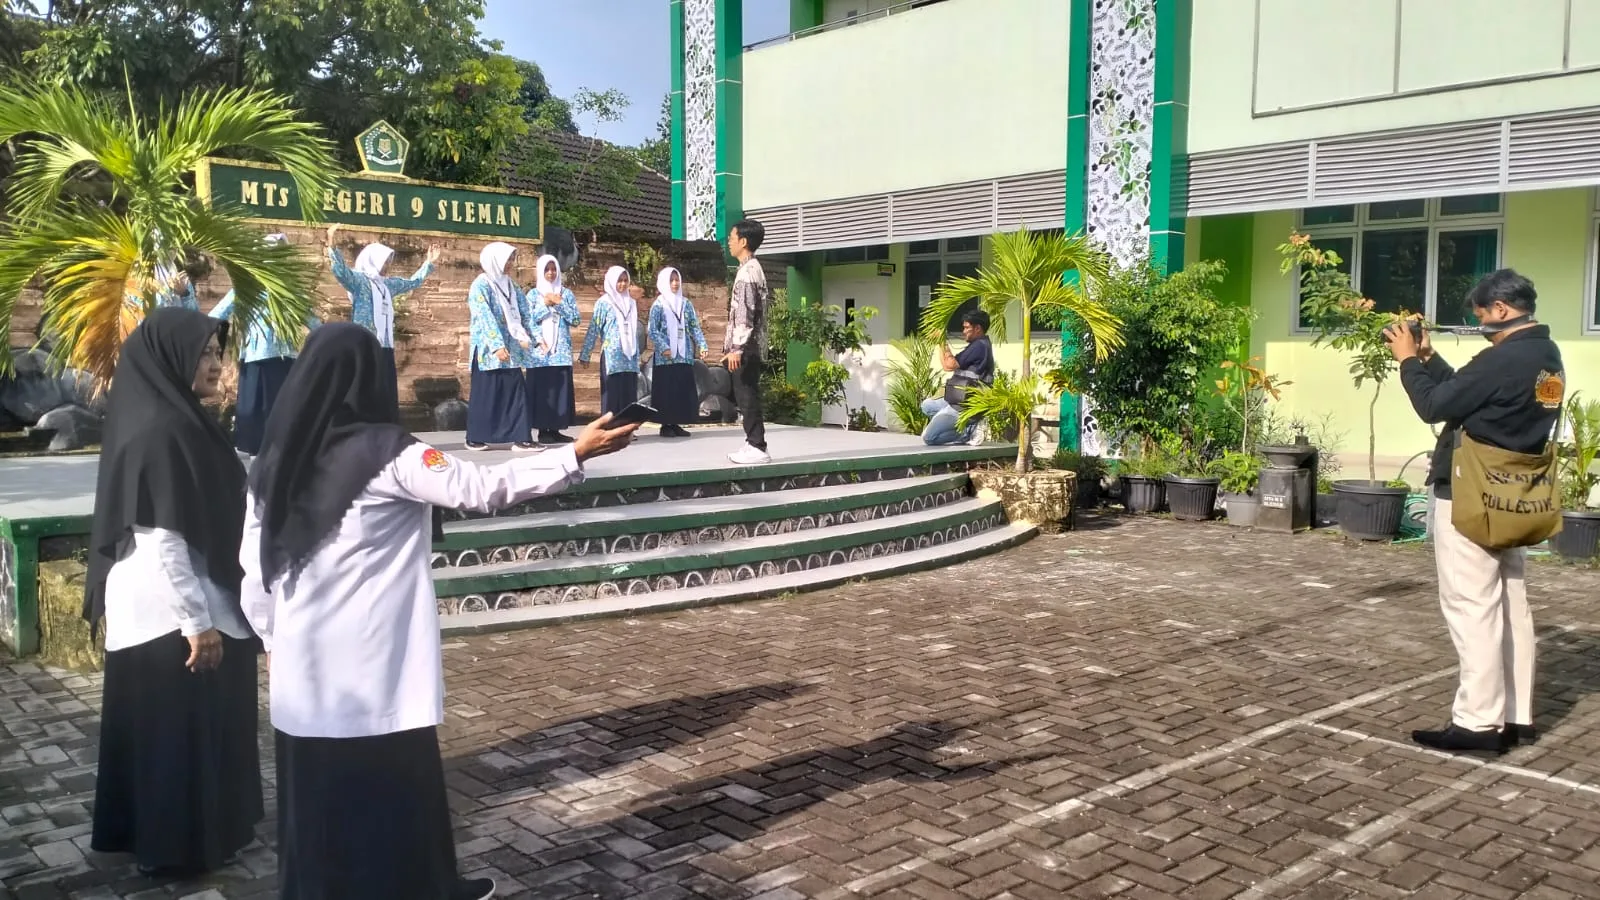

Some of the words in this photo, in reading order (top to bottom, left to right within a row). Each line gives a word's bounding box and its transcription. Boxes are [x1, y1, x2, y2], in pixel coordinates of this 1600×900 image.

[241, 180, 289, 207] MTs
[322, 188, 396, 217] EGERI
[411, 197, 424, 218] 9
[438, 199, 520, 226] SLEMAN
